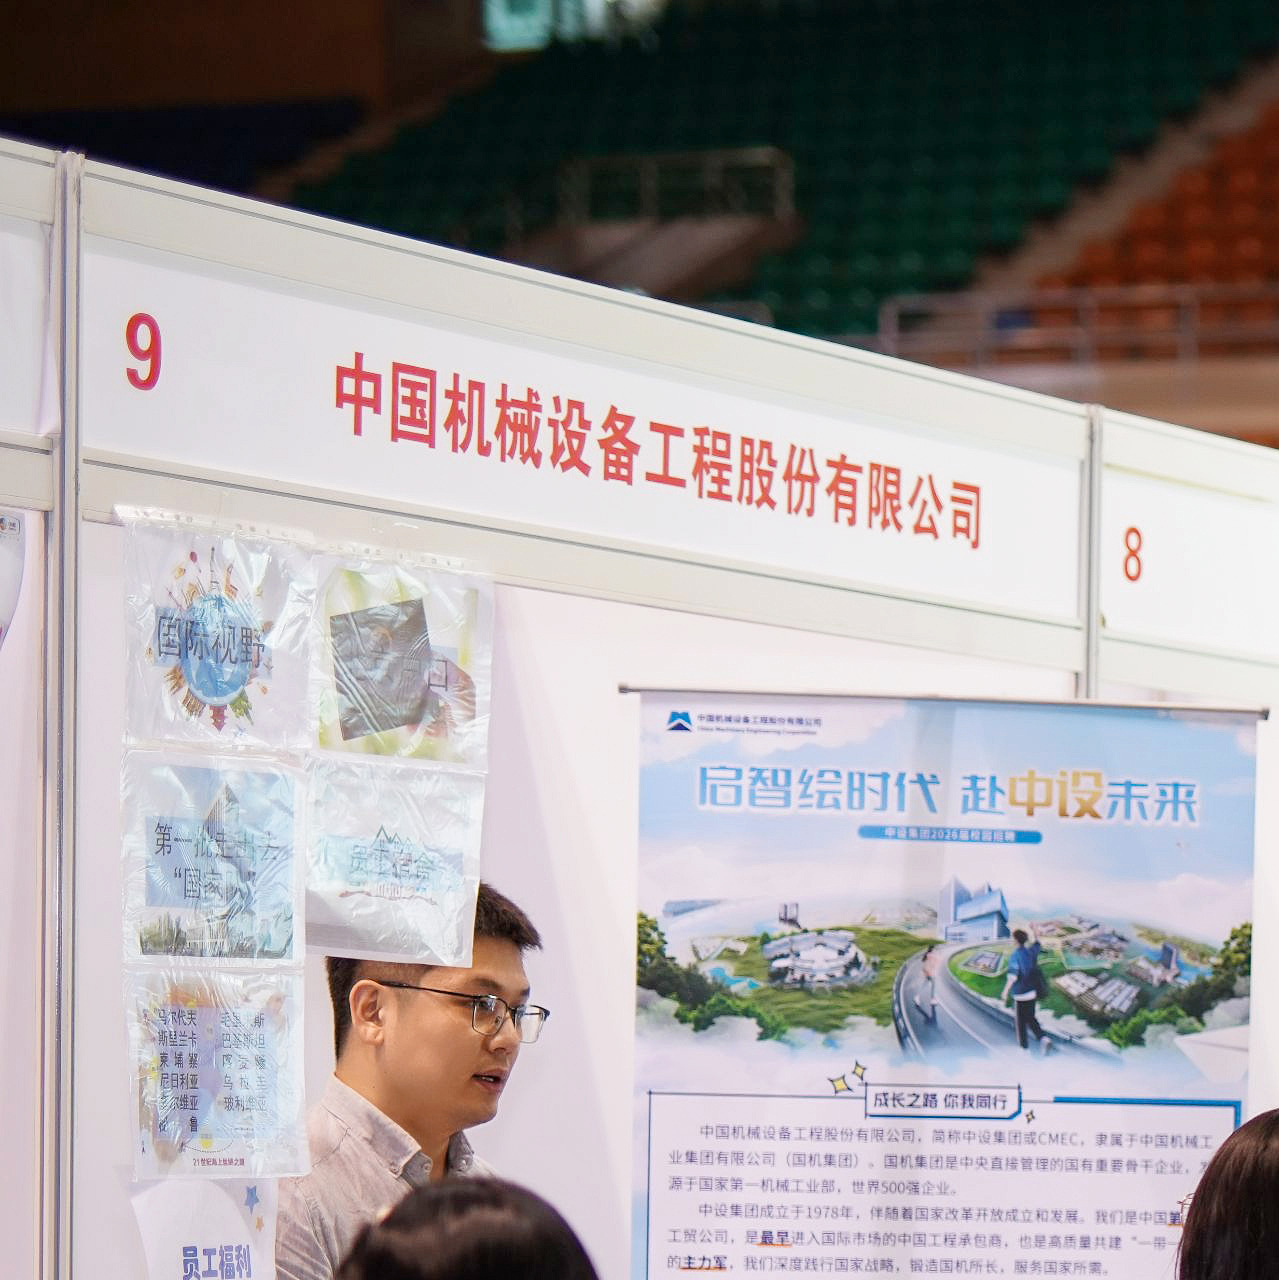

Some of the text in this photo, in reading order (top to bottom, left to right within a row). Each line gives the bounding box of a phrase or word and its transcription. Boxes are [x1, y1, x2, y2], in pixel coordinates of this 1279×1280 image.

[125, 312, 162, 391] 9
[335, 351, 981, 551] 中国机械设备工程股份有限公司
[1124, 527, 1143, 581] 8
[157, 615, 266, 669] 国际视野
[699, 766, 1198, 822] 启智绘时代 赴中设未来
[158, 1031, 198, 1047] 斯里兰卡
[160, 1073, 199, 1090] 尼日利亚
[874, 1092, 1008, 1111] 成长之路 你我同行
